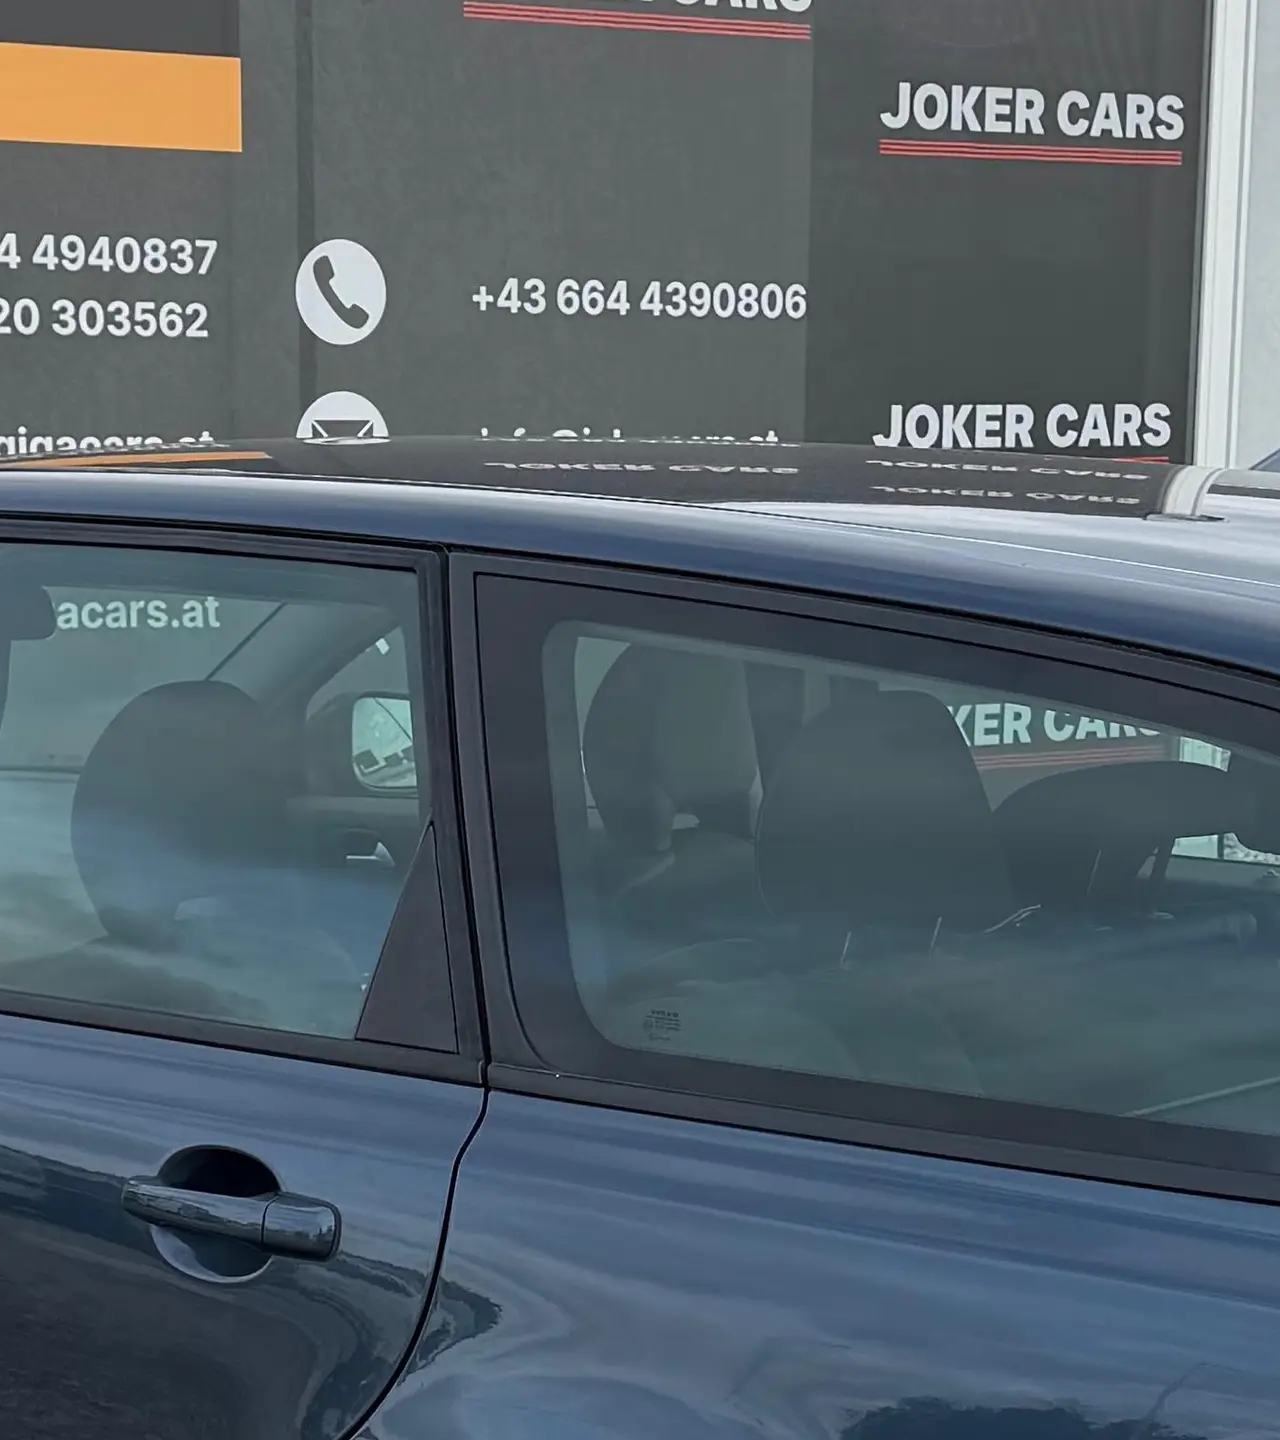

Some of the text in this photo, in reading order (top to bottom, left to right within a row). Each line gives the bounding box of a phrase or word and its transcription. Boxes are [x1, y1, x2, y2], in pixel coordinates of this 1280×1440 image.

[880, 82, 1185, 141] JOKER CARS
[32, 234, 218, 275] 4940837
[51, 298, 209, 338] 303562
[472, 277, 807, 319] +43 664 4390806
[872, 402, 1171, 449] JOKER CARS
